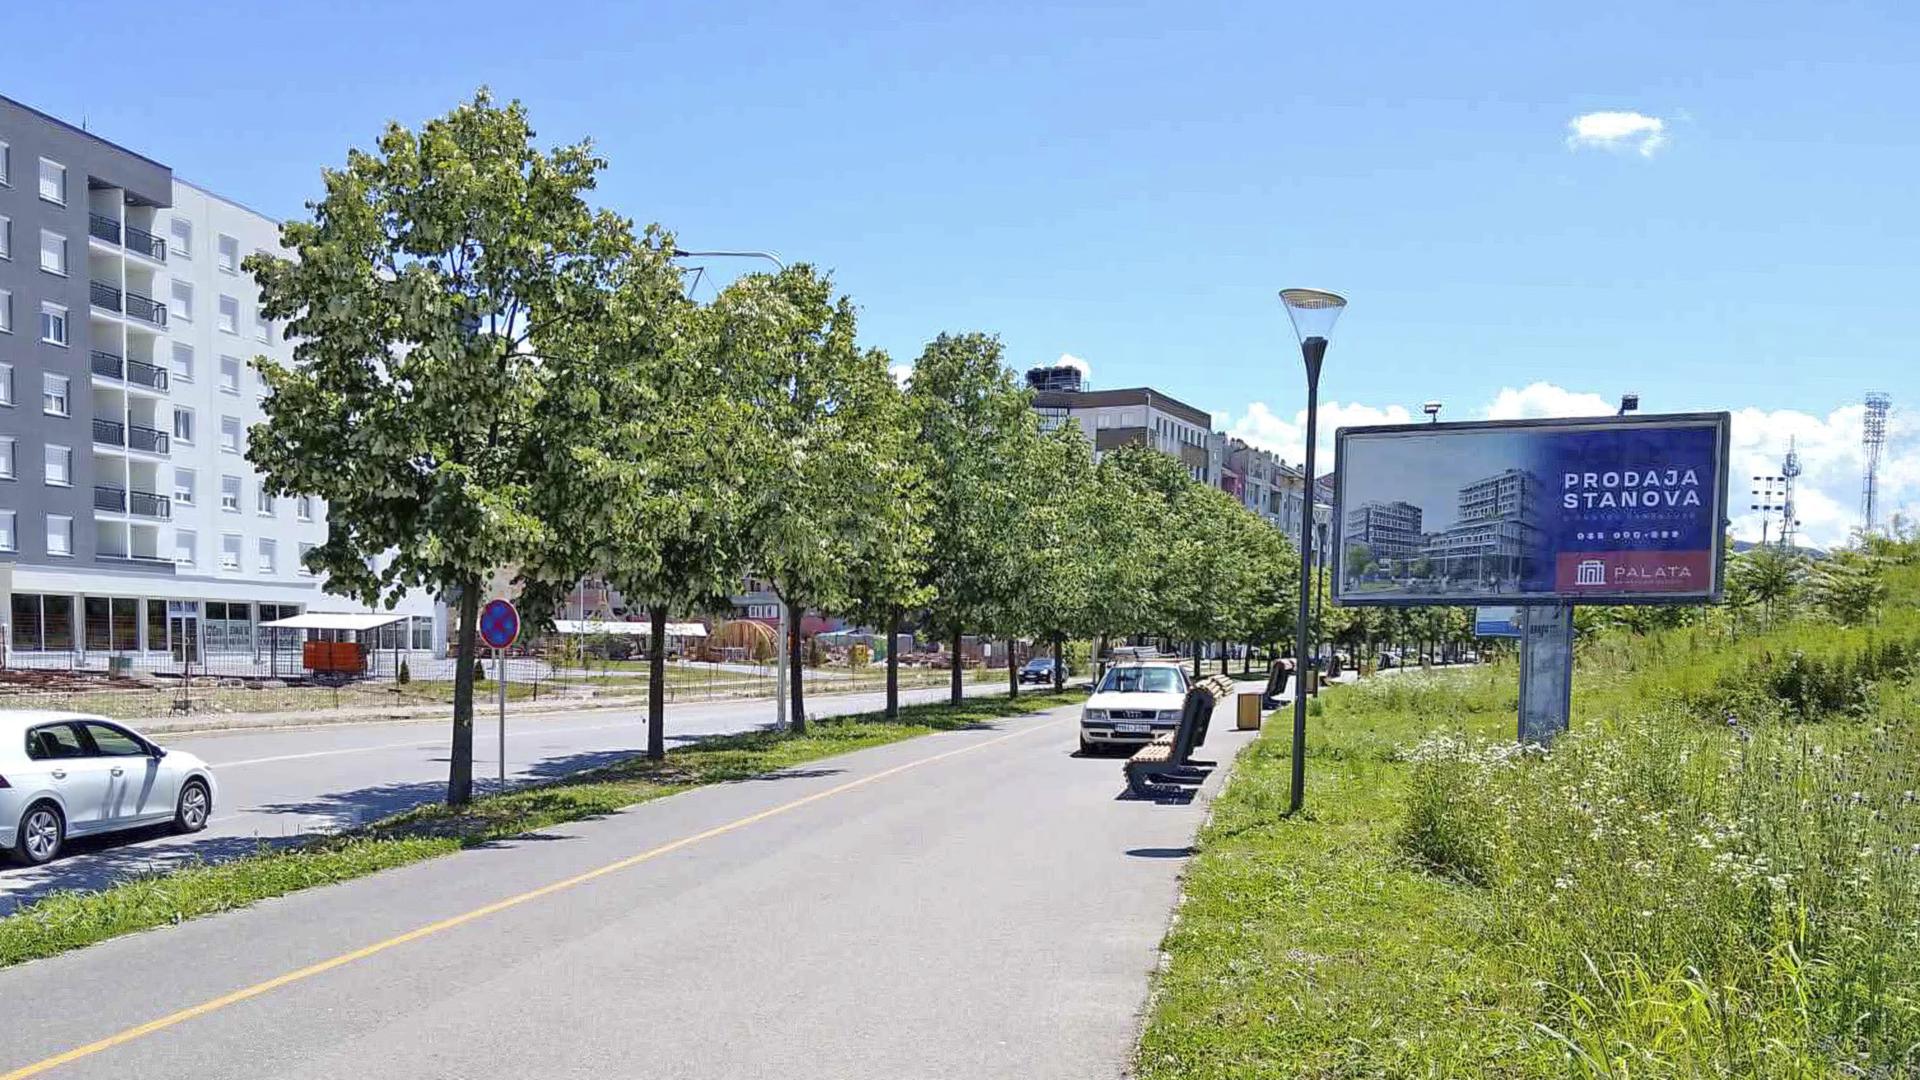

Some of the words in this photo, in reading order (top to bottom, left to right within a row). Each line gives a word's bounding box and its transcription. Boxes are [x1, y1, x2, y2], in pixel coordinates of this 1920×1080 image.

[1564, 469, 1700, 489] PRODAJA
[1563, 489, 1701, 509] STANOVA
[1614, 565, 1692, 579] PALATA
